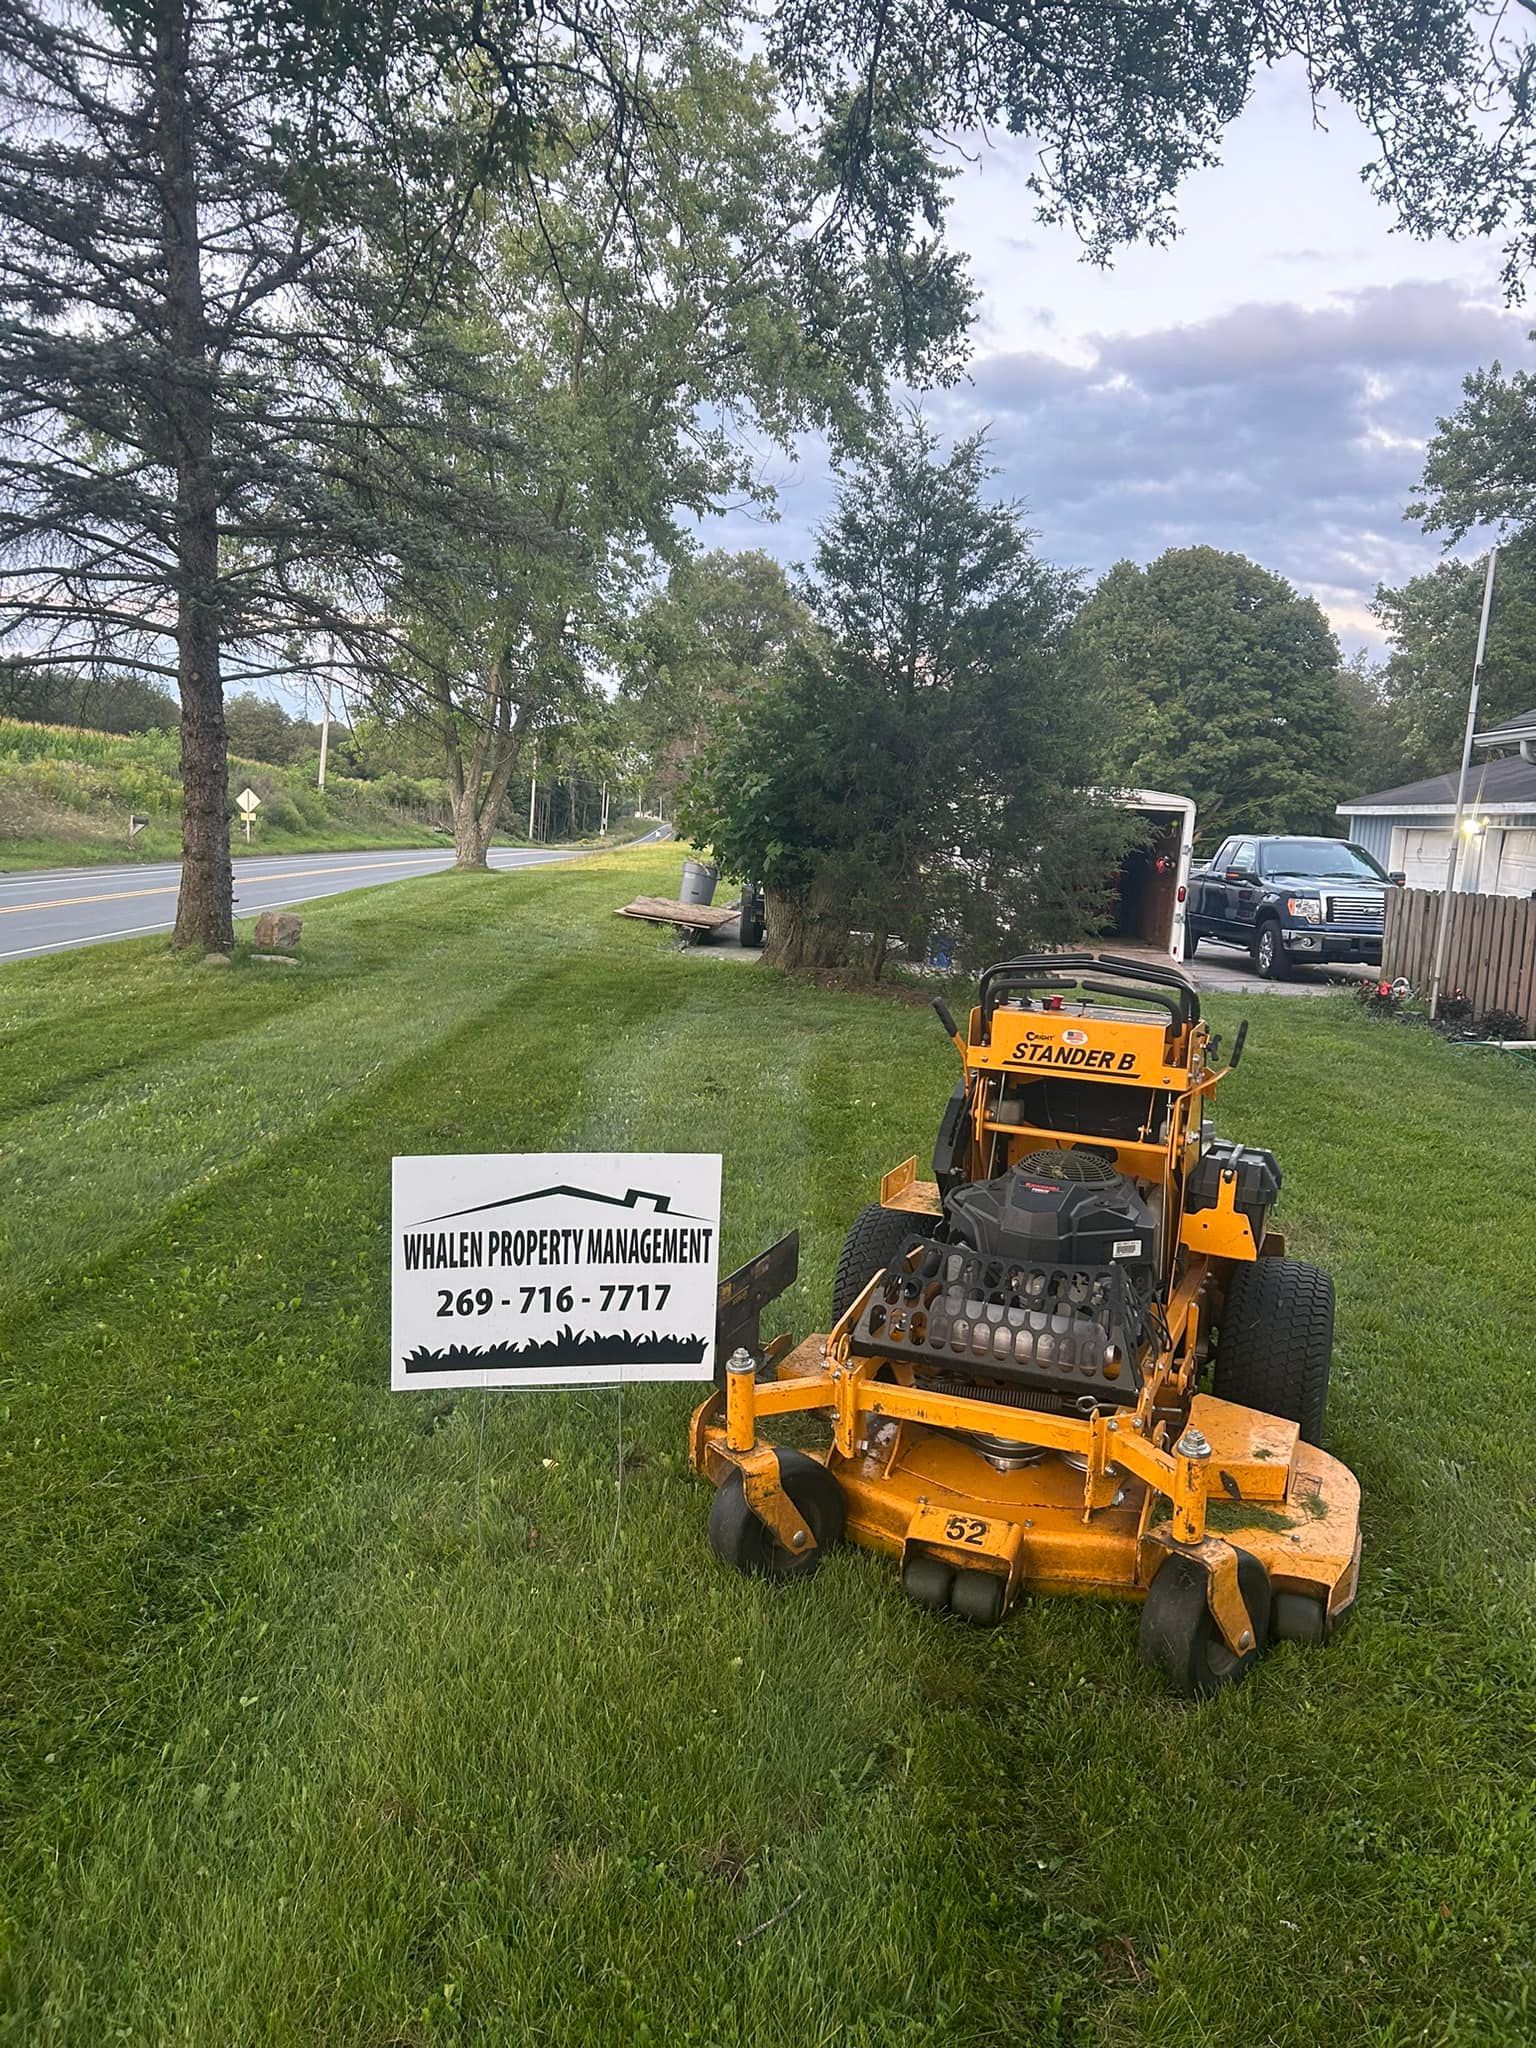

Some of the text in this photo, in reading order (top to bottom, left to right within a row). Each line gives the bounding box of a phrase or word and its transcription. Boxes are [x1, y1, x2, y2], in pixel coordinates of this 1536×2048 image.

[1012, 1042, 1136, 1071] STANDER B
[403, 1228, 713, 1271] WHALEN PROPERTY MANAGEMENT
[436, 1287, 493, 1317] 269
[519, 1285, 574, 1314] 716
[599, 1284, 671, 1312] 7717
[946, 1517, 987, 1546] 52
